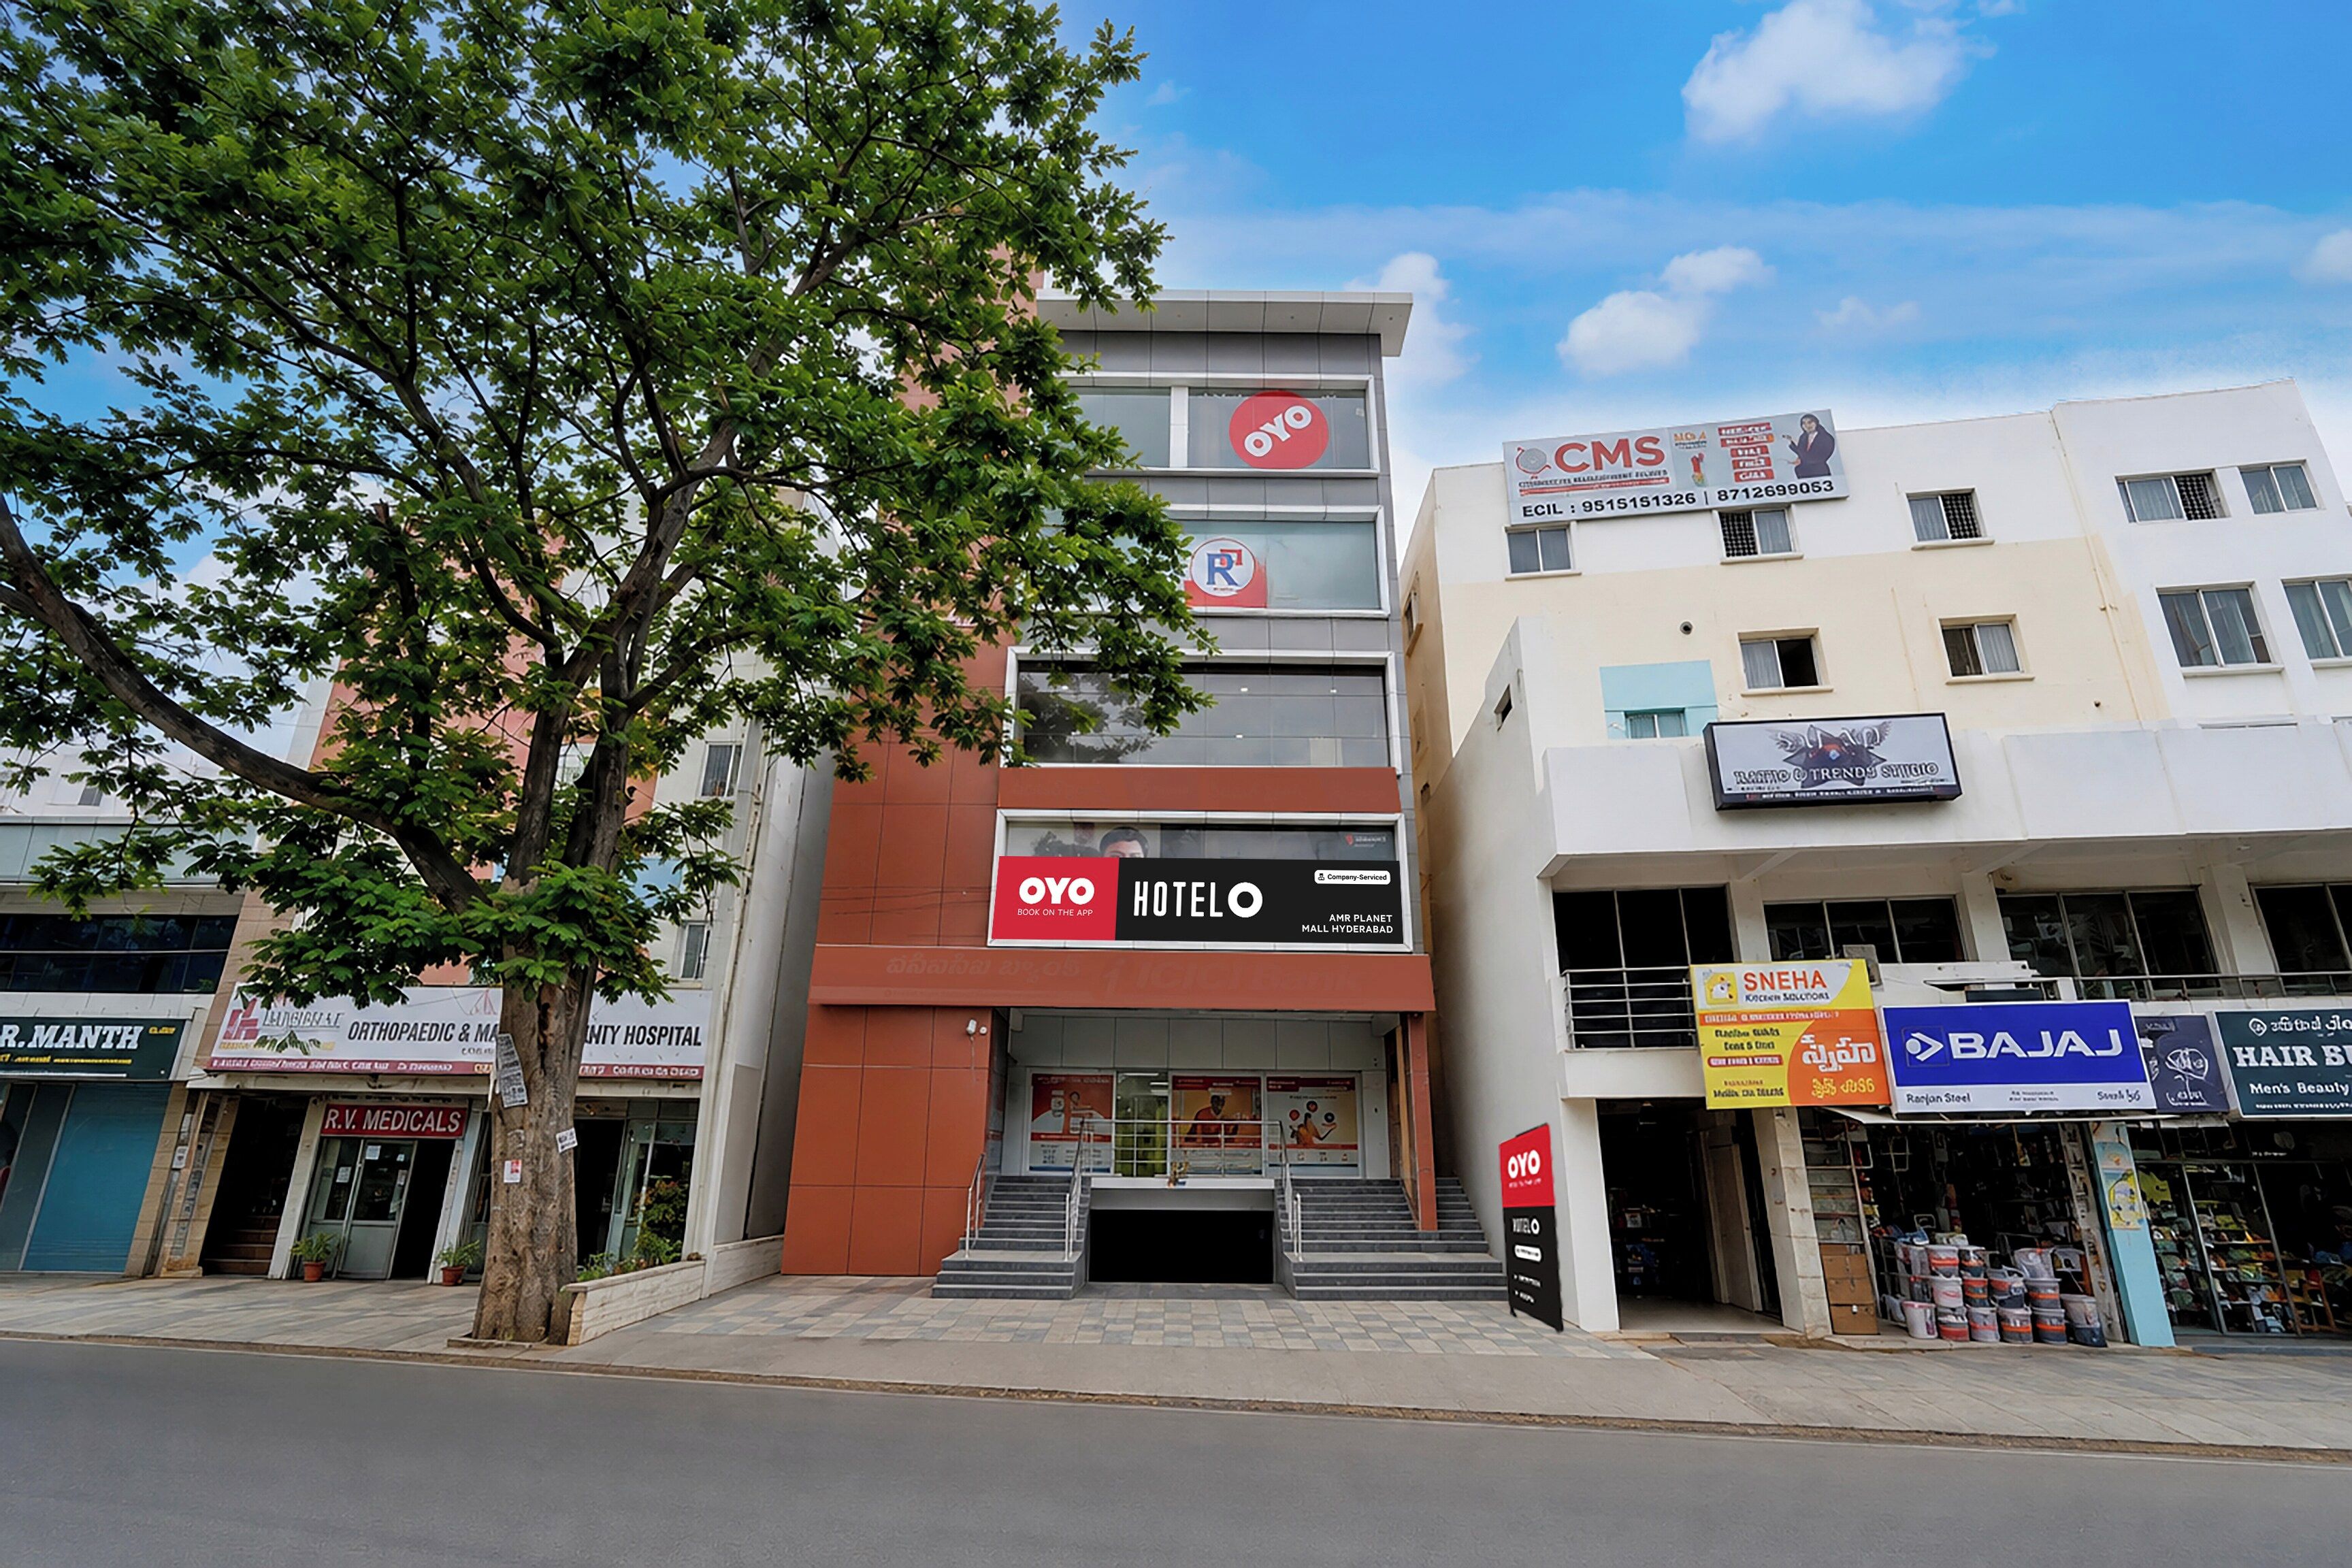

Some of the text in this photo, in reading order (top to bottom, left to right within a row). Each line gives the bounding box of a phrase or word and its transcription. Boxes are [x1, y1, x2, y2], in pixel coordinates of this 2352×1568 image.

[1244, 406, 1312, 457] OYO
[1554, 436, 1665, 473] CMS
[1522, 504, 1563, 517] ECIL
[1019, 877, 1094, 905] OYO
[1133, 881, 1224, 917] HOTEL
[1017, 908, 1093, 917] BOOK ON THE APP
[1329, 914, 1392, 923] AMR PLANET
[1302, 924, 1393, 934] MALL HYDERABAD
[1744, 970, 1827, 991] SNEHA
[348, 1022, 455, 1042] ORTHOPAEDIC
[458, 1023, 470, 1042] &
[585, 1025, 621, 1045] NITY
[623, 1025, 702, 1046] HOSPITAL
[1948, 1029, 2123, 1059] BAJAJ
[2232, 1045, 2317, 1066] HAIR
[2249, 1082, 2349, 1096] Men's Beauty
[325, 1109, 461, 1132] R.V. MEDICALS
[1507, 1149, 1541, 1179] OYO
